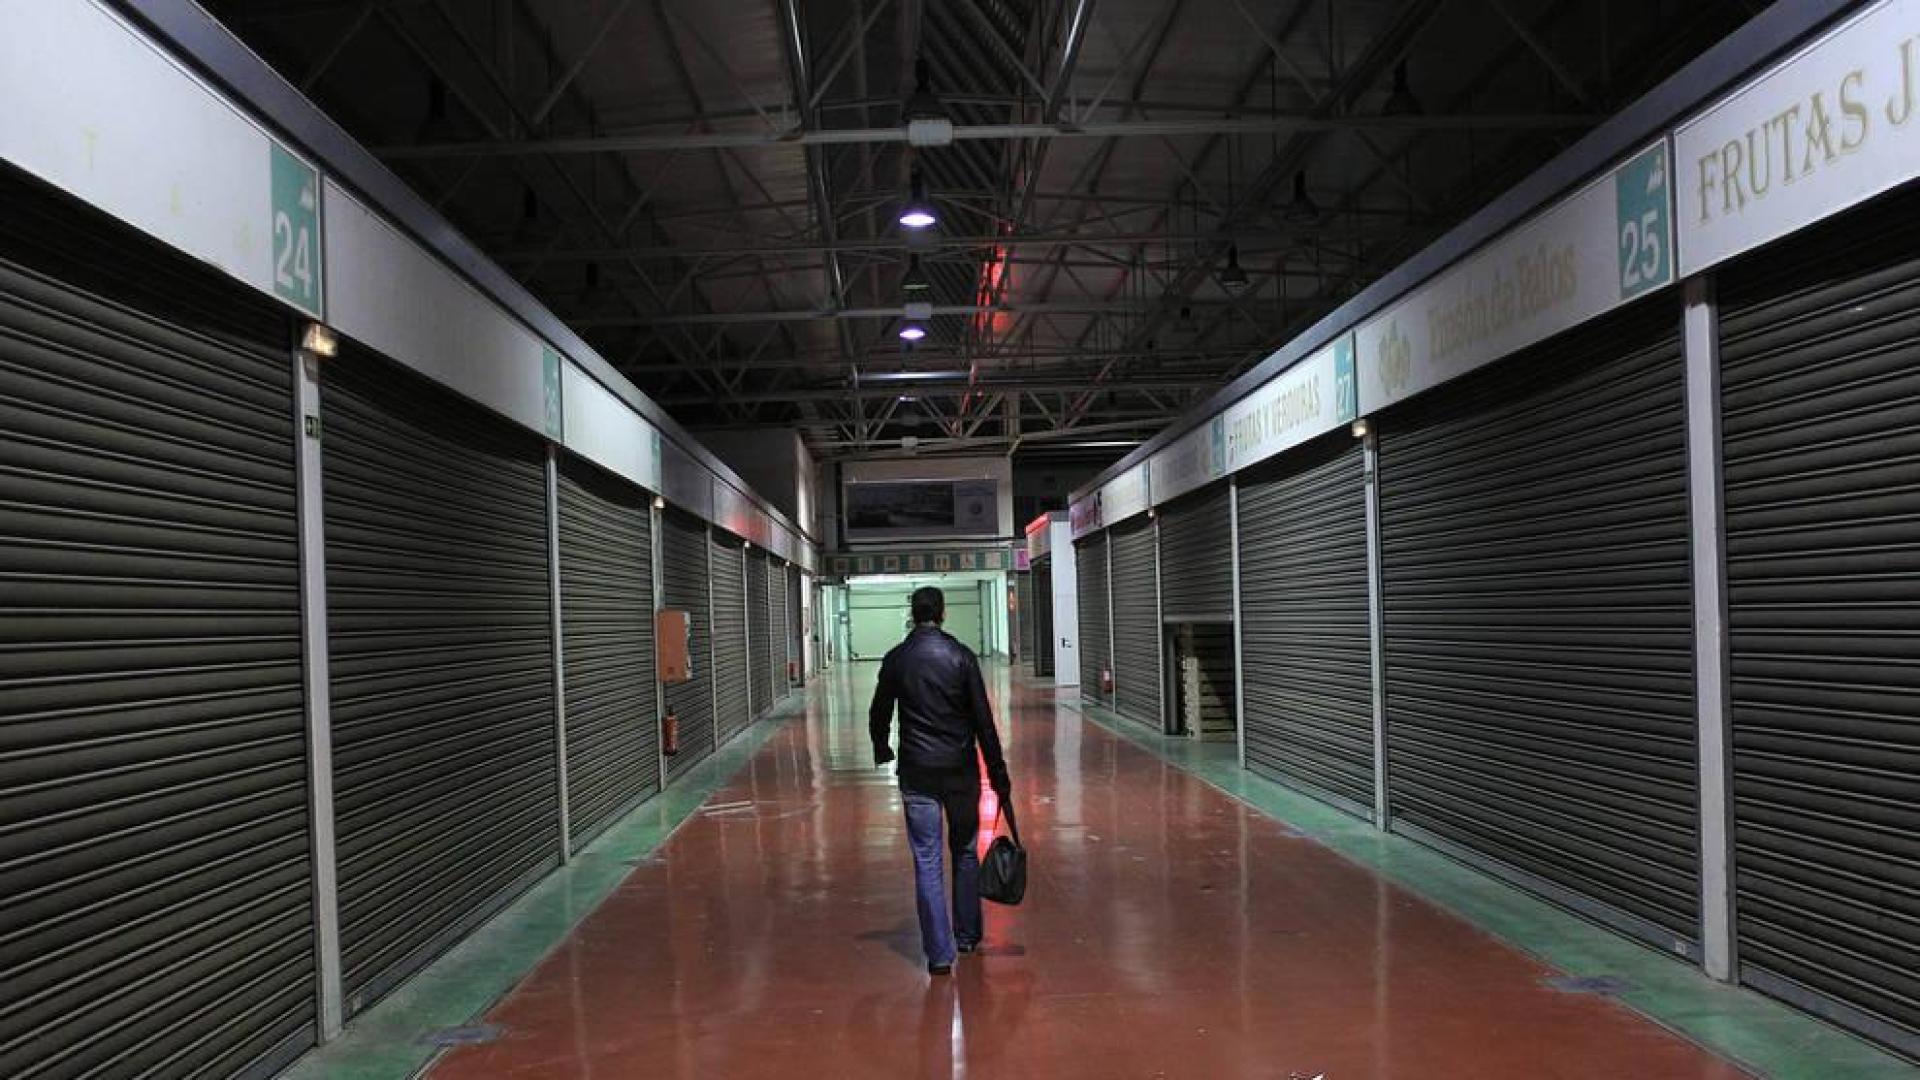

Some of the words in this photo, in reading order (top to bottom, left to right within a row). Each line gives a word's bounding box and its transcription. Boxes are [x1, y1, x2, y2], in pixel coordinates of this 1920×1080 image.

[1698, 71, 1868, 222] FRUTAS
[1885, 32, 1920, 126] J
[274, 209, 311, 298] 24
[1621, 208, 1660, 287] 25
[1337, 373, 1351, 415] 27
